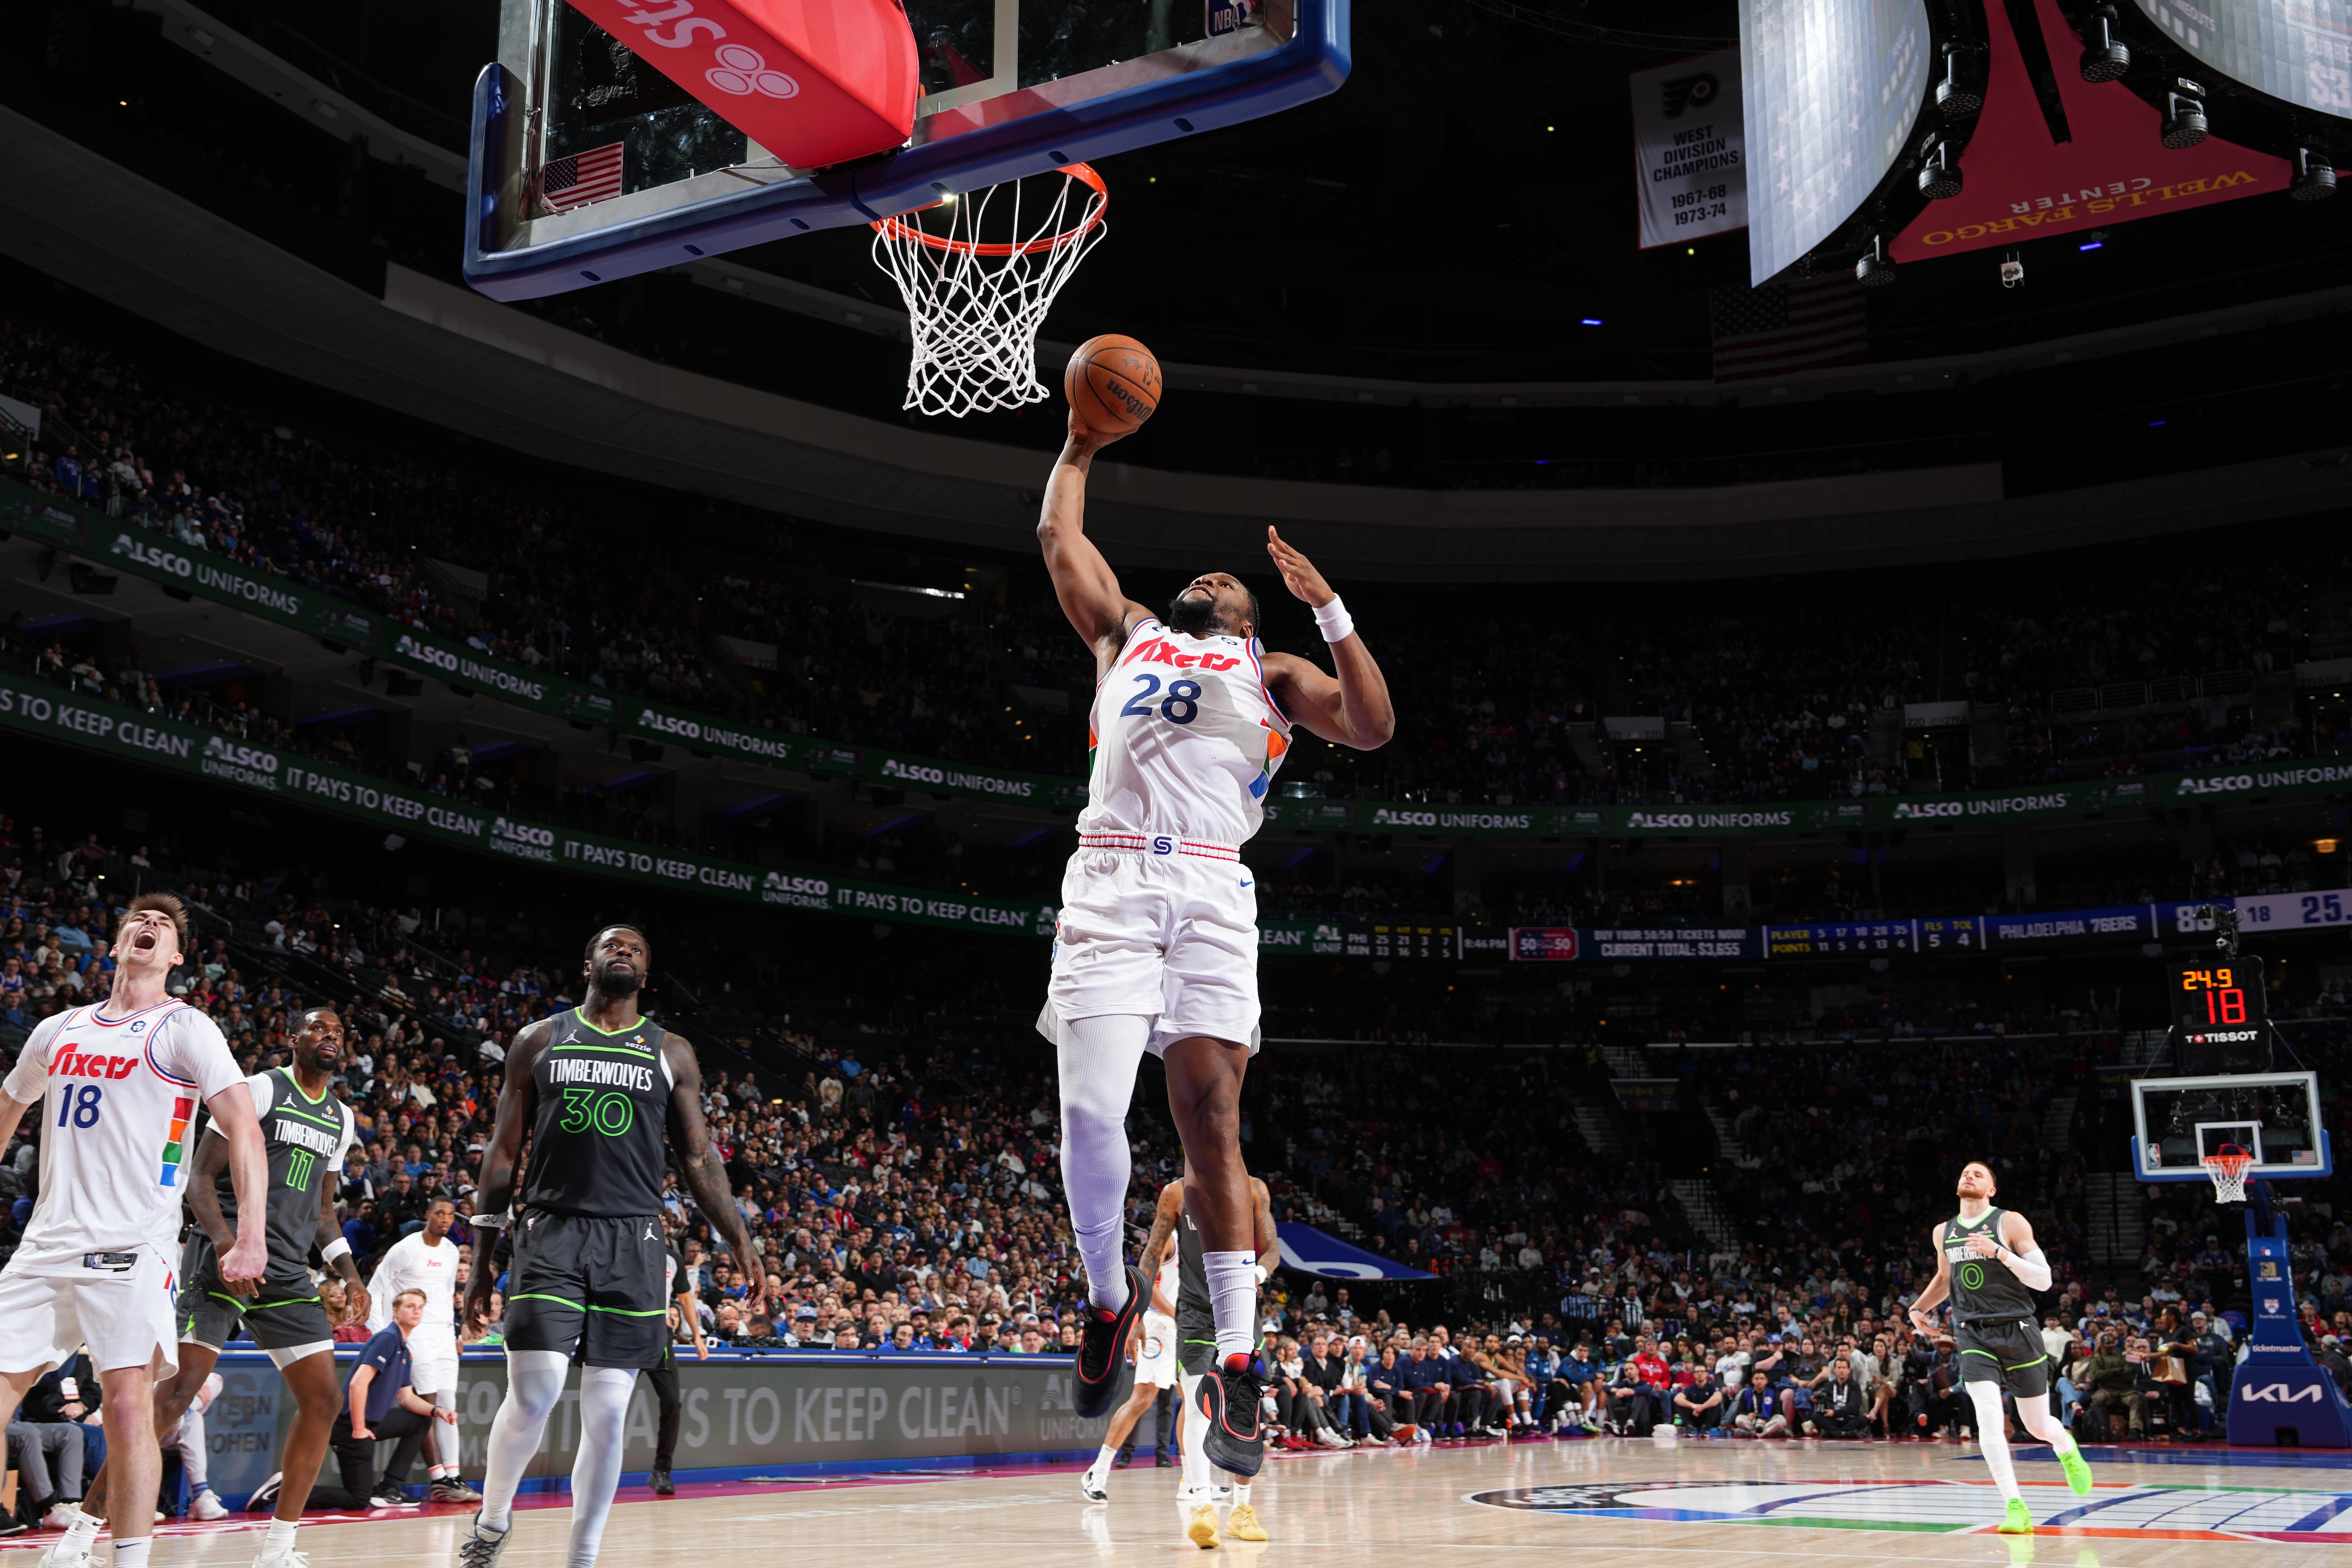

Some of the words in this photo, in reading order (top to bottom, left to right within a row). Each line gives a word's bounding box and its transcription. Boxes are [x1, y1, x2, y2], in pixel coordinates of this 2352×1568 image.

[615, 0, 727, 48] St
[1214, 6, 1240, 32] NBA
[1674, 125, 1713, 146] WEST
[1664, 138, 1725, 164] DIVISION
[1653, 151, 1739, 182] CHAMPIONS
[1671, 184, 1726, 209] 1967-68
[2010, 177, 2152, 214] CENTER
[2086, 171, 2259, 215] WELLS
[1674, 203, 1726, 225] 1973-74
[1923, 205, 2077, 246] FARGO
[1106, 377, 1153, 422] Wilson
[111, 533, 192, 577] ALSCO
[196, 564, 298, 614] UNIFORMS
[396, 635, 457, 671] ALSCO
[460, 658, 542, 700] UNIFORMS
[1119, 674, 1202, 725] 28
[19, 693, 52, 721] TO
[57, 704, 114, 737] KEEP
[118, 722, 189, 758] CLEAN
[638, 708, 700, 738] ALSCO
[703, 725, 787, 758] UNIFORMS
[203, 735, 278, 773] ALSCO
[200, 758, 277, 791] UNIFORMS
[882, 759, 944, 784] ALSCO
[946, 771, 1033, 797] UNIFORMS
[2177, 775, 2254, 796] ALSCO
[286, 766, 304, 788] IT
[306, 772, 351, 801] PAYS
[354, 786, 380, 809] TO
[382, 793, 425, 820] KEEP
[427, 806, 482, 837] CLEAN
[1893, 802, 1963, 819] ALSCO
[1967, 792, 2067, 815] UNIFORMS
[490, 816, 555, 847] ALSCO
[1373, 808, 1435, 827] ALSCO
[1438, 813, 1529, 829] UNIFORMS
[1627, 812, 1693, 828] ALSCO
[1697, 811, 1791, 828] UNIFORMS
[489, 836, 553, 862] UNIFORMS
[564, 840, 581, 858] IT
[583, 844, 626, 868] PAYS
[628, 852, 653, 873] TO
[655, 857, 697, 881] KEEP
[699, 867, 753, 891] CLEAN
[763, 871, 829, 896] ALSCO
[762, 890, 829, 910] UNIFORMS
[837, 889, 853, 905] IT
[855, 891, 898, 912] PAYS
[900, 897, 924, 915] TO
[926, 900, 968, 921] KEEP
[969, 906, 1026, 927] CLEAN
[1999, 920, 2086, 939] PHILADELPHIA
[2090, 915, 2137, 933] 76ERS
[2249, 906, 2270, 923] 18
[1259, 930, 1301, 946] EAN
[1520, 938, 1536, 950] 50
[1553, 938, 1571, 950] 50
[1771, 930, 1811, 940] PLAYER
[1772, 943, 1812, 953] POINTS
[1929, 933, 1941, 948] 5
[1957, 932, 1971, 947] 4
[1601, 943, 1654, 956] CURRENT
[2182, 969, 2233, 990] 24.9
[2207, 988, 2246, 1025] 18
[625, 1041, 652, 1053] sezzle
[2204, 1030, 2257, 1043] TISSOT
[48, 1043, 139, 1080] Sixers
[549, 1059, 653, 1091] TIMBERWOLVES
[58, 1083, 102, 1129] 18
[321, 1112, 339, 1122] sezzle
[560, 1088, 633, 1137] 30
[275, 1119, 338, 1158] TIMBERWOLVES
[286, 1147, 315, 1192] 11
[1945, 1245, 1996, 1265] TIMBERWOL
[1961, 1263, 1984, 1290] 0
[2252, 1344, 2302, 1353] ticketmaster
[203, 1395, 272, 1417] TERN
[722, 1385, 781, 1446] TO
[795, 1386, 889, 1444] KEEP
